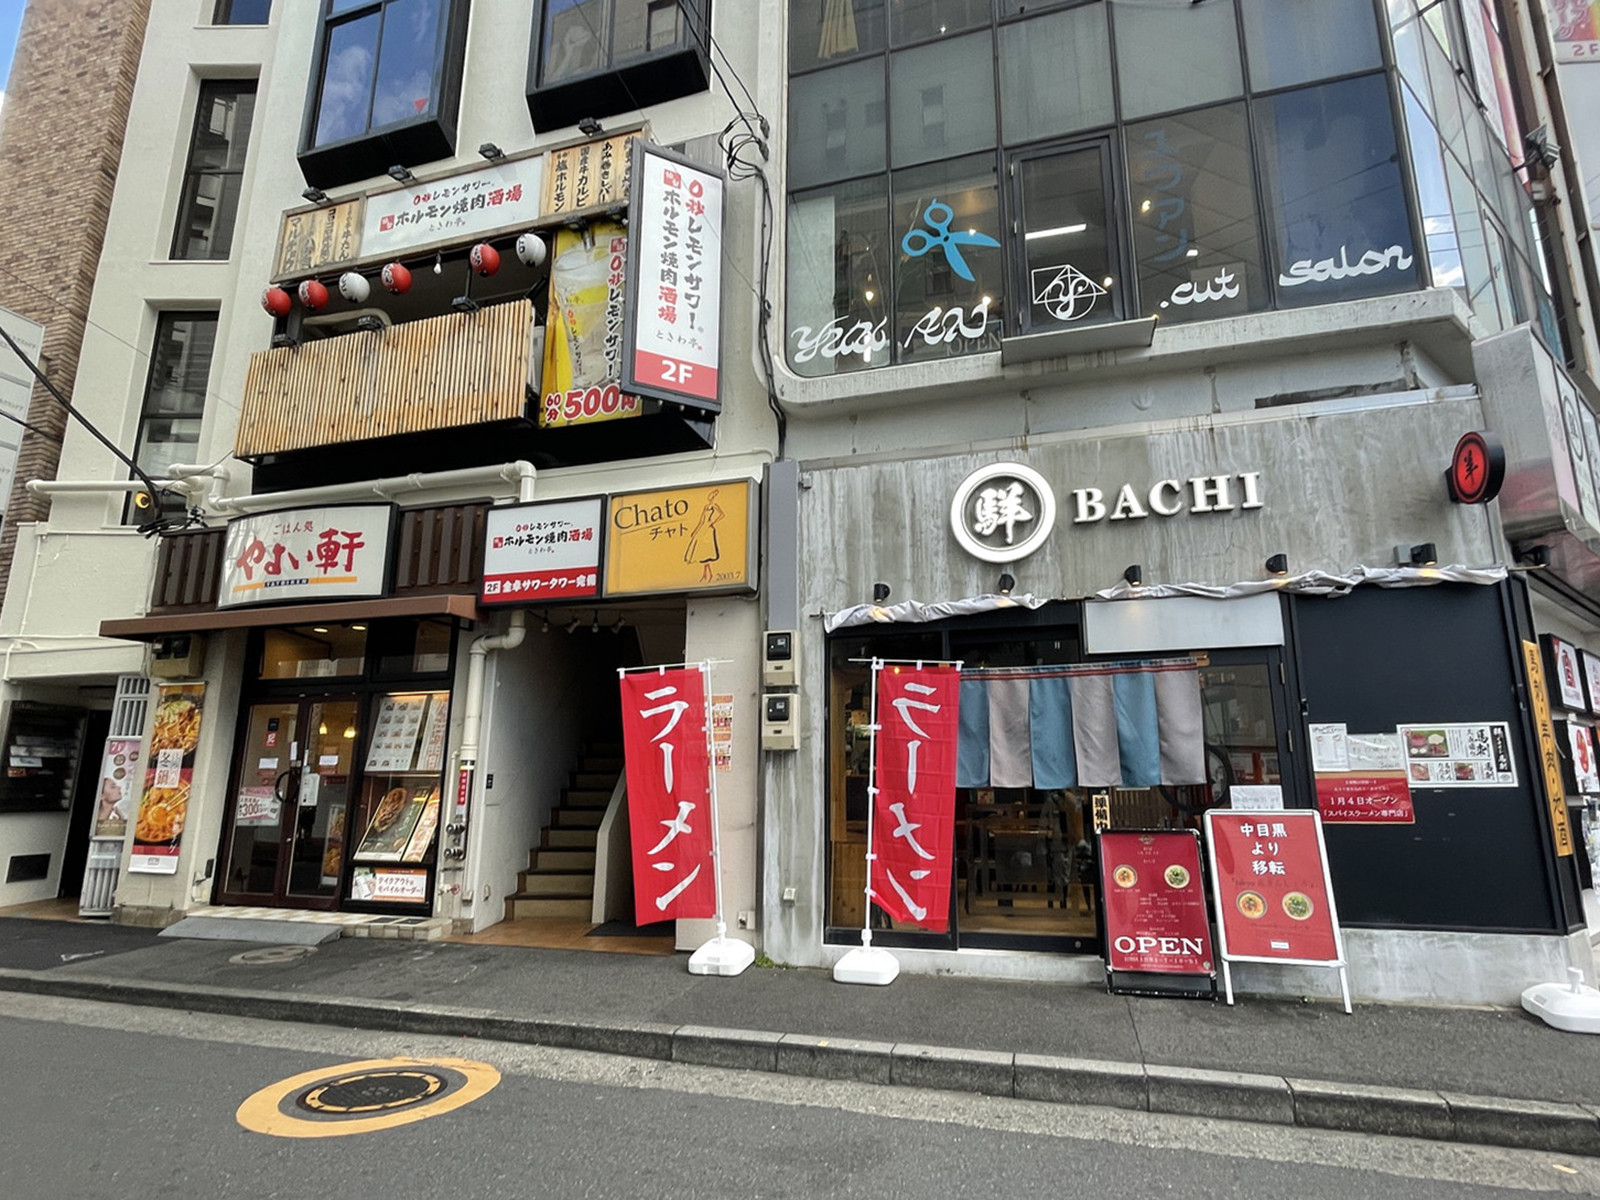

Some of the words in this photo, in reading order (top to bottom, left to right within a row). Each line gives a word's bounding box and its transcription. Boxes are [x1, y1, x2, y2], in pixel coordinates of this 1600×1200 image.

[1572, 43, 1599, 56] 2F
[554, 152, 569, 213] 塩ホルモン
[395, 184, 523, 227] ホルモン焼肉酒場
[657, 189, 682, 325] ホルモン焼肉酒場
[1279, 245, 1413, 286] salon
[661, 360, 693, 384] 2F
[546, 393, 561, 406] 60
[1072, 471, 1265, 524] BACHI
[614, 499, 689, 530] Chato
[273, 520, 314, 536] ごはん処
[503, 527, 594, 547] ホルモン焼肉酒場
[649, 523, 689, 541] チャト
[236, 528, 365, 581] やよい軒
[487, 582, 499, 592] 2F
[639, 685, 701, 911] ラーメン
[1330, 795, 1399, 806] 1月4日オープン
[1240, 822, 1288, 838] 中目黒
[1251, 841, 1280, 857] より
[1251, 860, 1287, 875] 移転
[1114, 936, 1204, 956] OPEN
